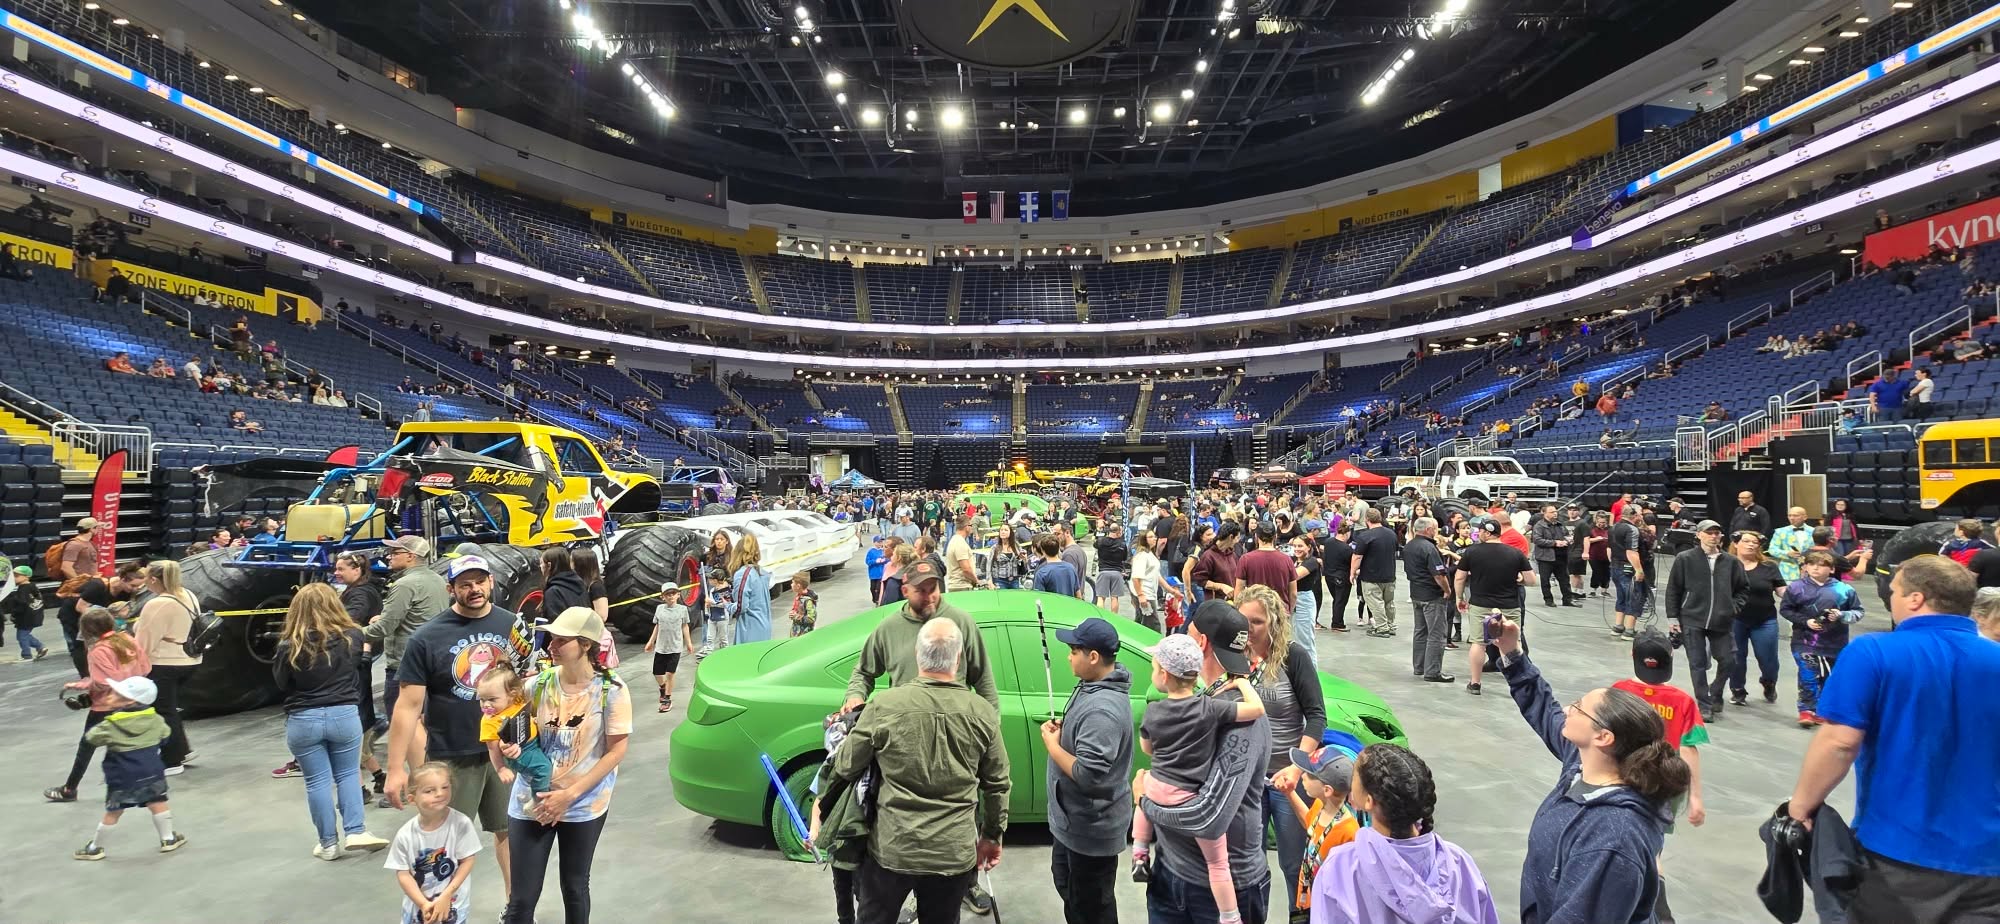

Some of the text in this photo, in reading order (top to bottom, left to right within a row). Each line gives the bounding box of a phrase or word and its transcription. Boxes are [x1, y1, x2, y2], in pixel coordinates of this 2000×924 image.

[131, 214, 149, 224] 112
[1355, 208, 1409, 225] VIDÉOTRON
[1585, 201, 1622, 234] beneva
[630, 219, 682, 236] VIDÉOTRON
[1807, 224, 1822, 234] 121
[126, 270, 168, 292] ZONE
[465, 466, 534, 487] Black Stallion
[555, 501, 595, 520] safety-kleen
[449, 638, 469, 655] DO
[469, 634, 476, 643] I
